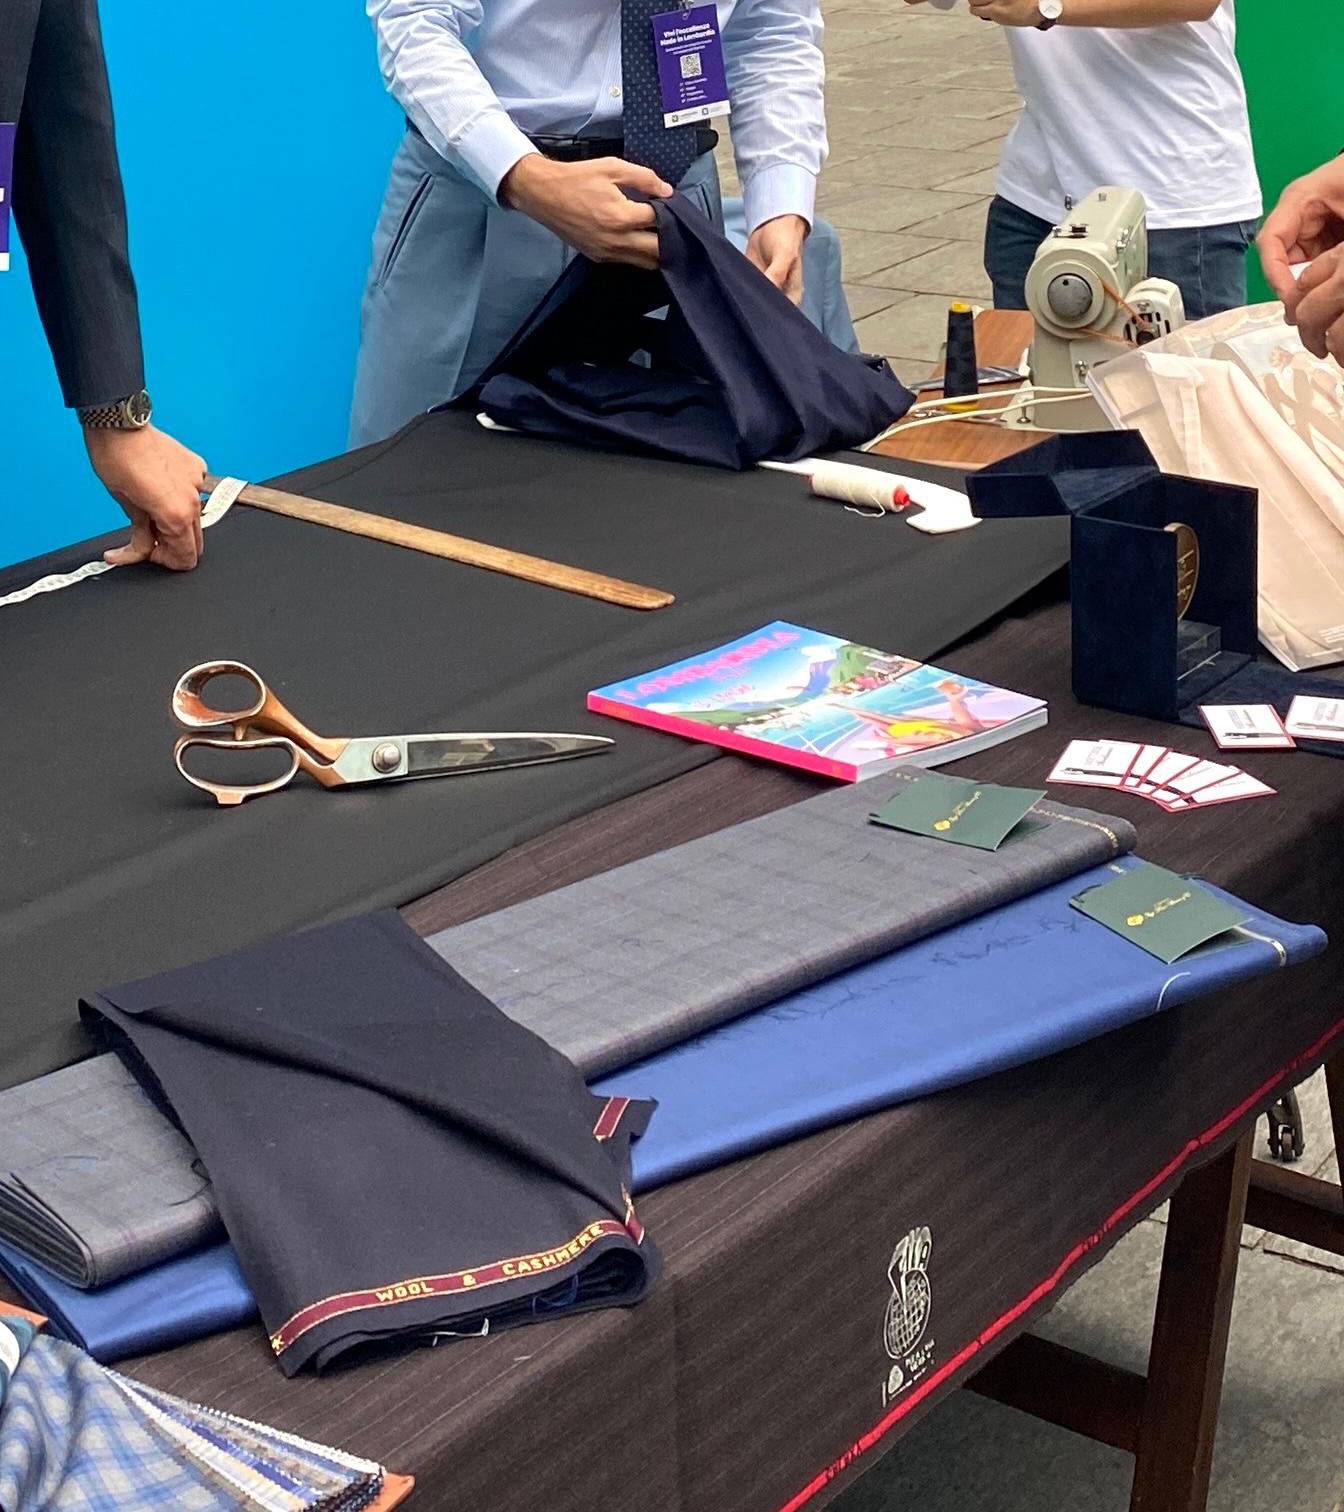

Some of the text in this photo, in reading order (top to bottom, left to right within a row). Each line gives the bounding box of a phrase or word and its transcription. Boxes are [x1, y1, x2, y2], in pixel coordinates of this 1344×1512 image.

[375, 1224, 604, 1302] WOOL & CASHMERE
